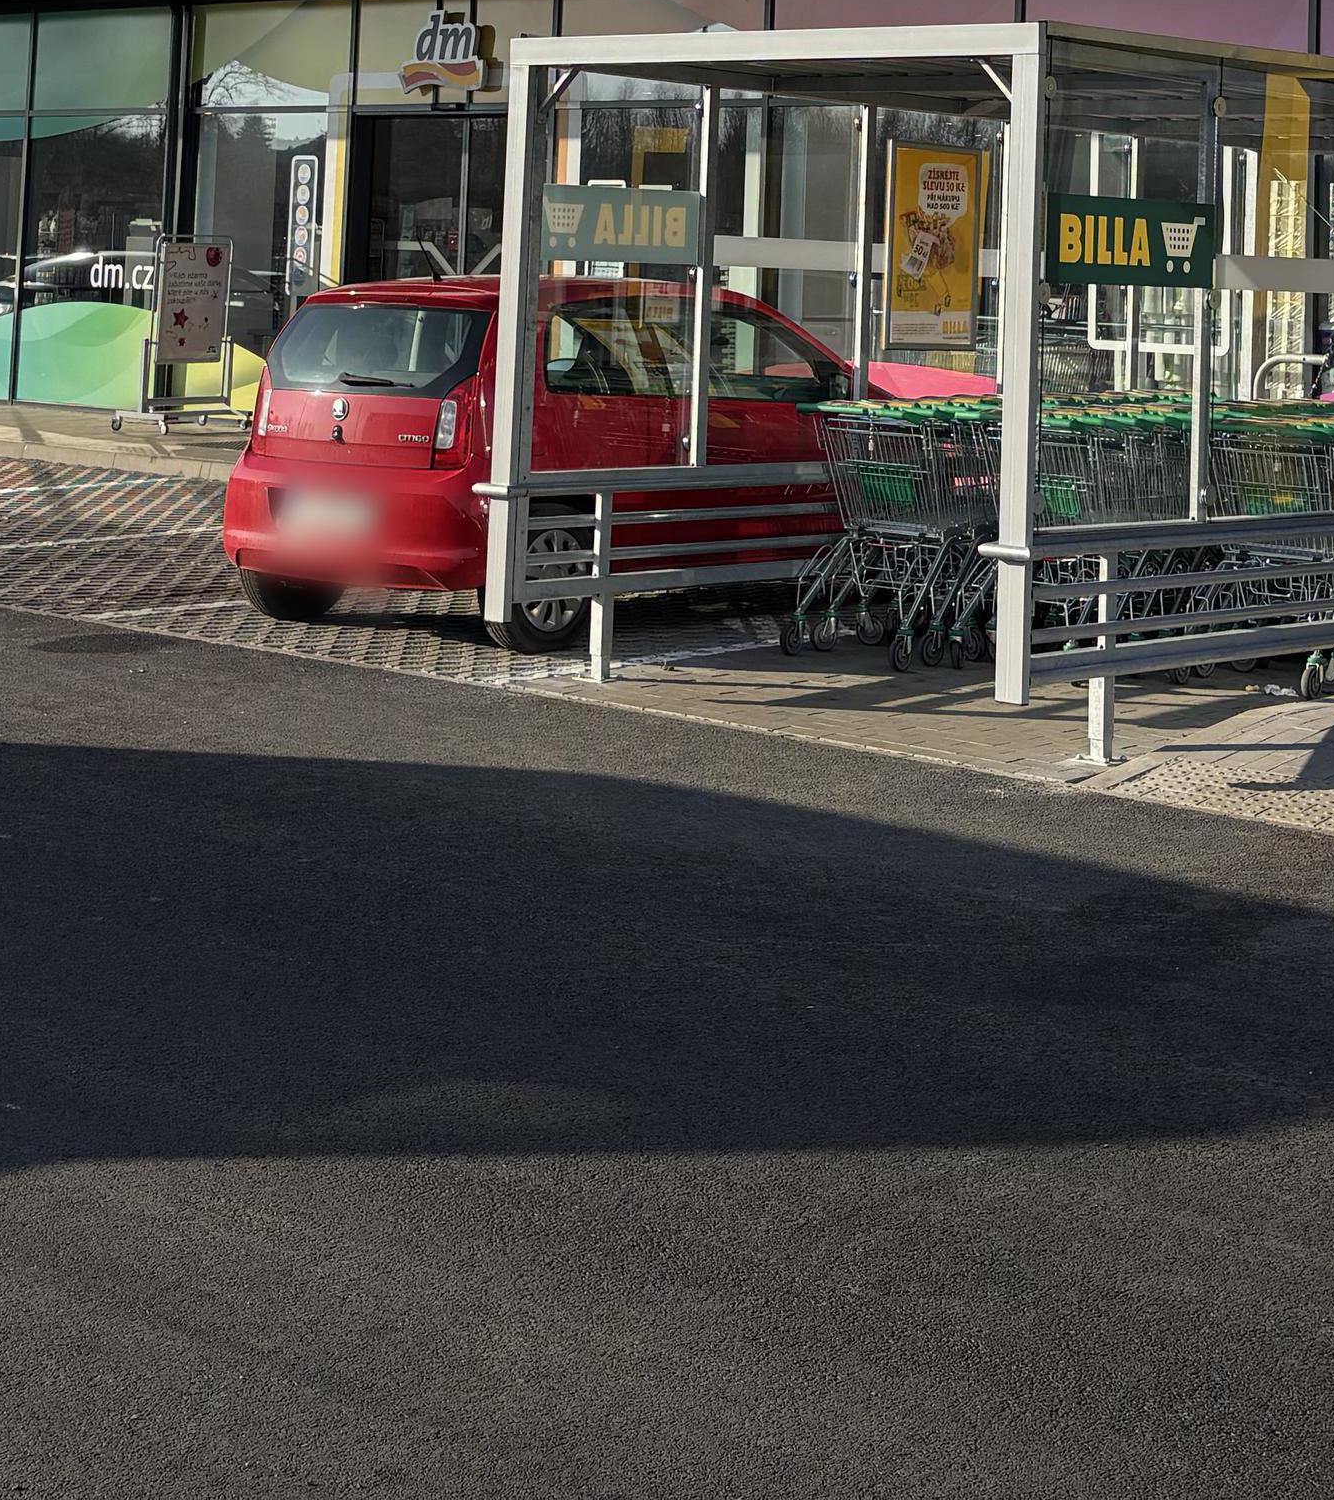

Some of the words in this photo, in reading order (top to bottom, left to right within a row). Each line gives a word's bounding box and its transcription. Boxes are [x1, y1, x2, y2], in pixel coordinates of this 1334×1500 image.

[415, 13, 474, 62] dm
[1058, 213, 1151, 267] BILLA
[90, 255, 155, 290] dm.cz
